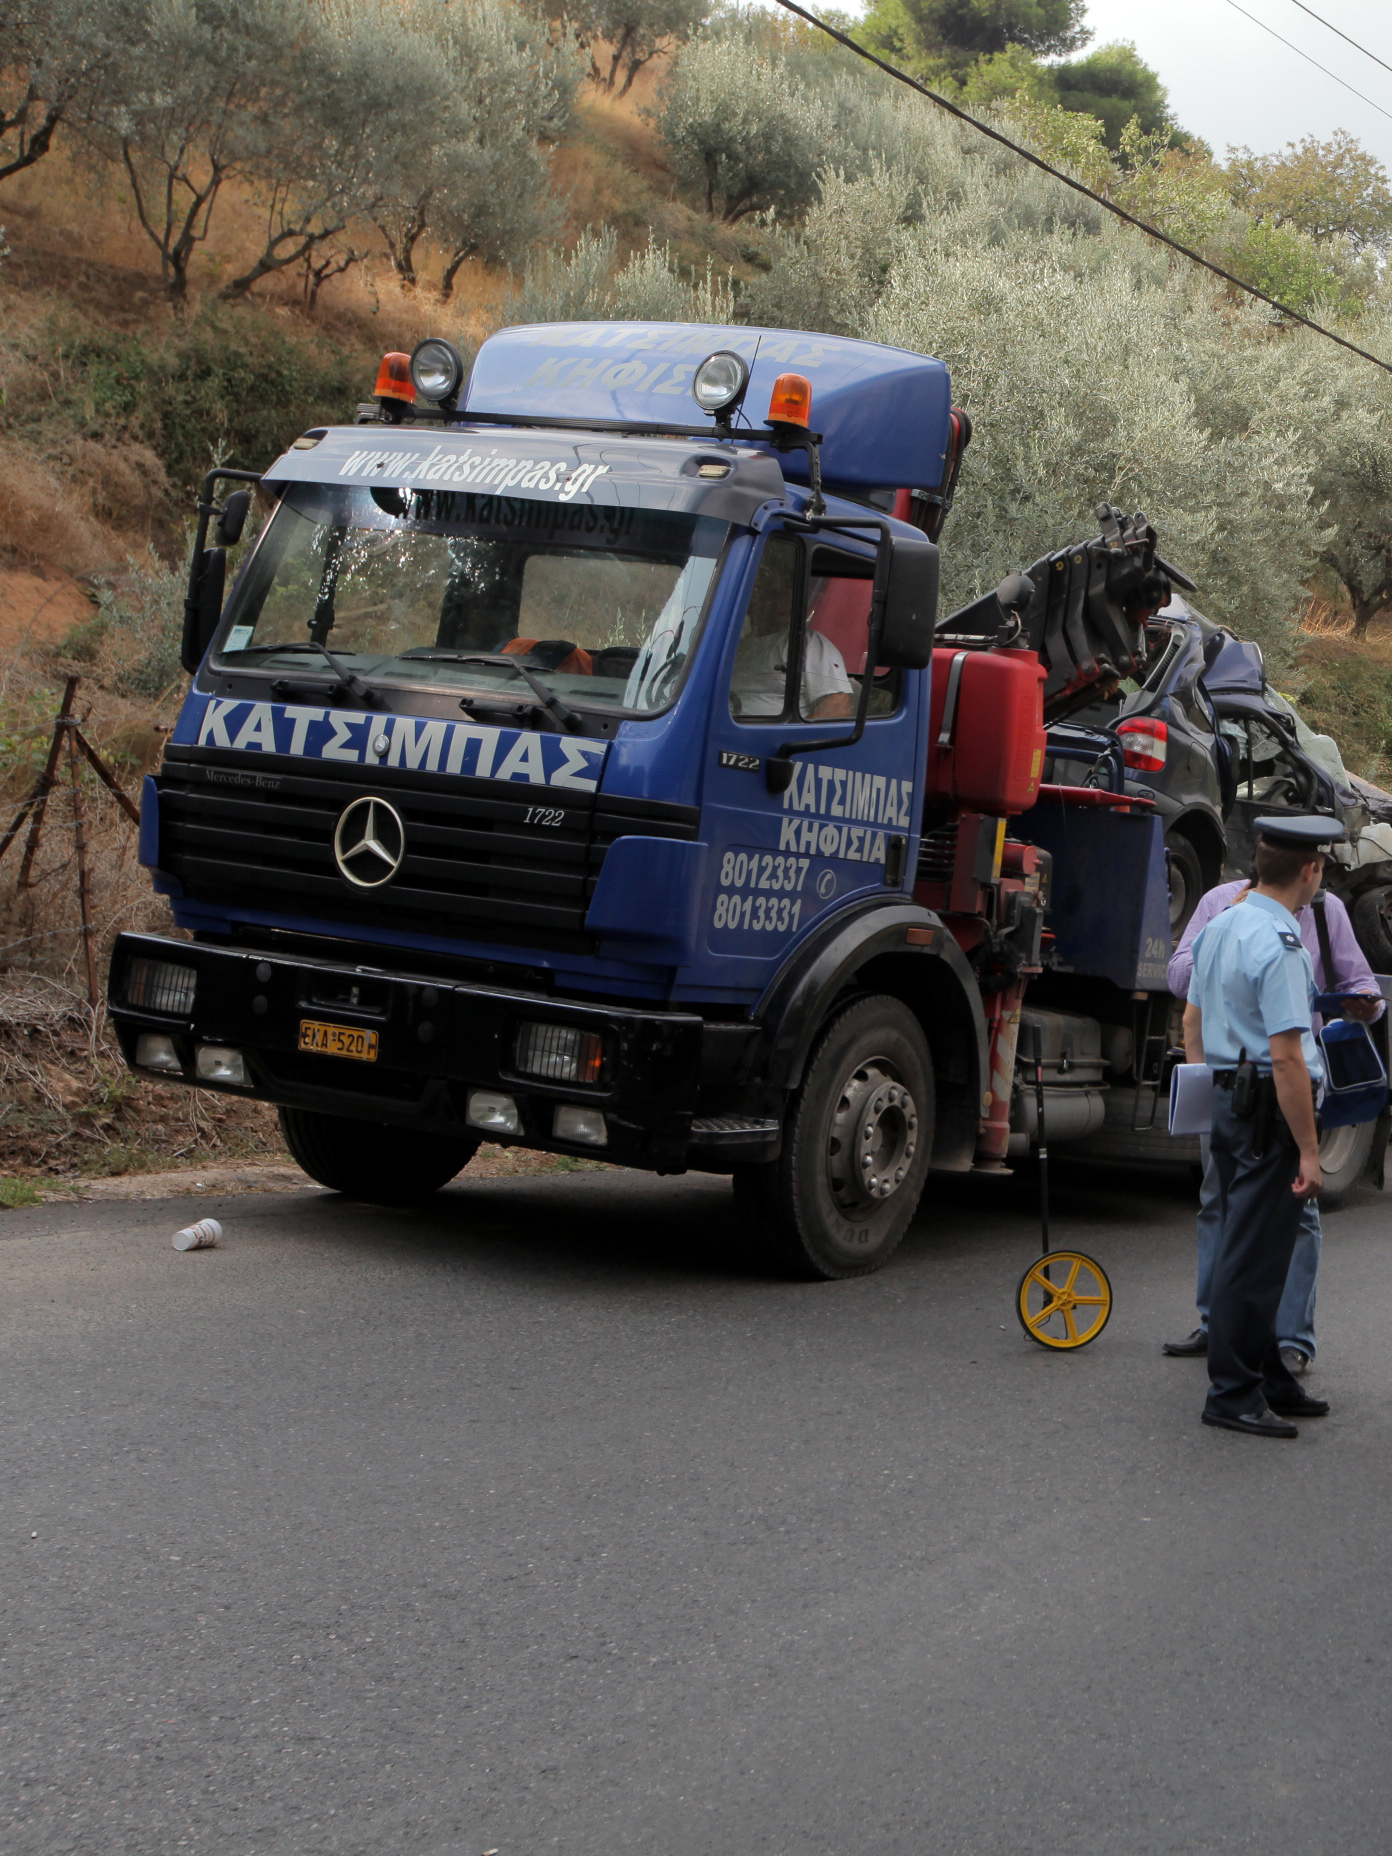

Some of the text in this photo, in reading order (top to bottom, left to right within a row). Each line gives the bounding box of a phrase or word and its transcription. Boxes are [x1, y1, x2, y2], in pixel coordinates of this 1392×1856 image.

[523, 357, 700, 396] ΚΗΦΙΣ
[338, 445, 611, 501] www.katsimpas.gr
[198, 699, 609, 793] ΚΑΤΣΙΜΠΑΣ
[722, 752, 760, 770] 1722
[204, 769, 282, 791] Mercedes-Benz
[783, 761, 914, 828] ΚΑΤΣΙΜΠΑΣ
[523, 806, 566, 827] 1722
[779, 817, 886, 865] ΚΗΦΙΣΙΑ
[720, 851, 811, 892] 8012337
[713, 893, 802, 932] 8013331
[1144, 937, 1165, 958] 24h
